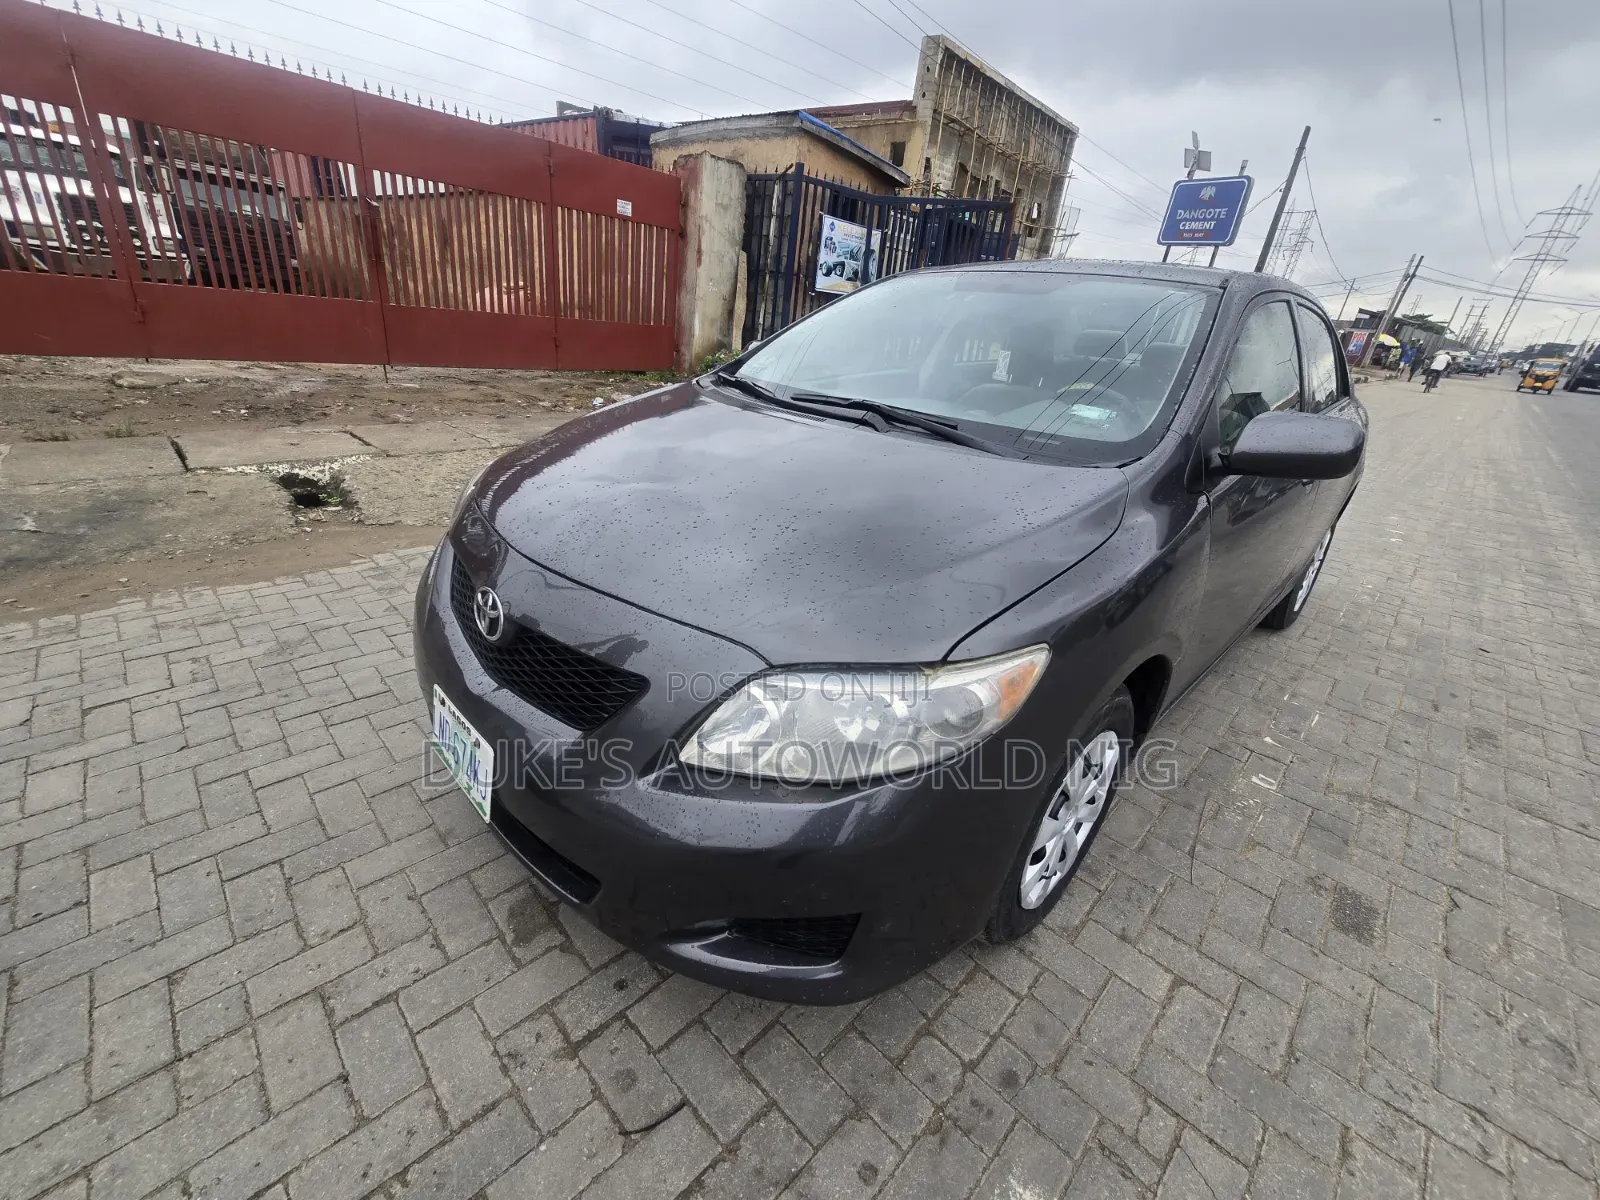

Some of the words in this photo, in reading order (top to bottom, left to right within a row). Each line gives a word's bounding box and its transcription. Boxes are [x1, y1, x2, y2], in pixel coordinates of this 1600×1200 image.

[1176, 208, 1228, 220] DANGOTE
[1180, 221, 1216, 230] CEMENT
[1353, 332, 1367, 343] POS
[448, 705, 472, 736] LAGOS
